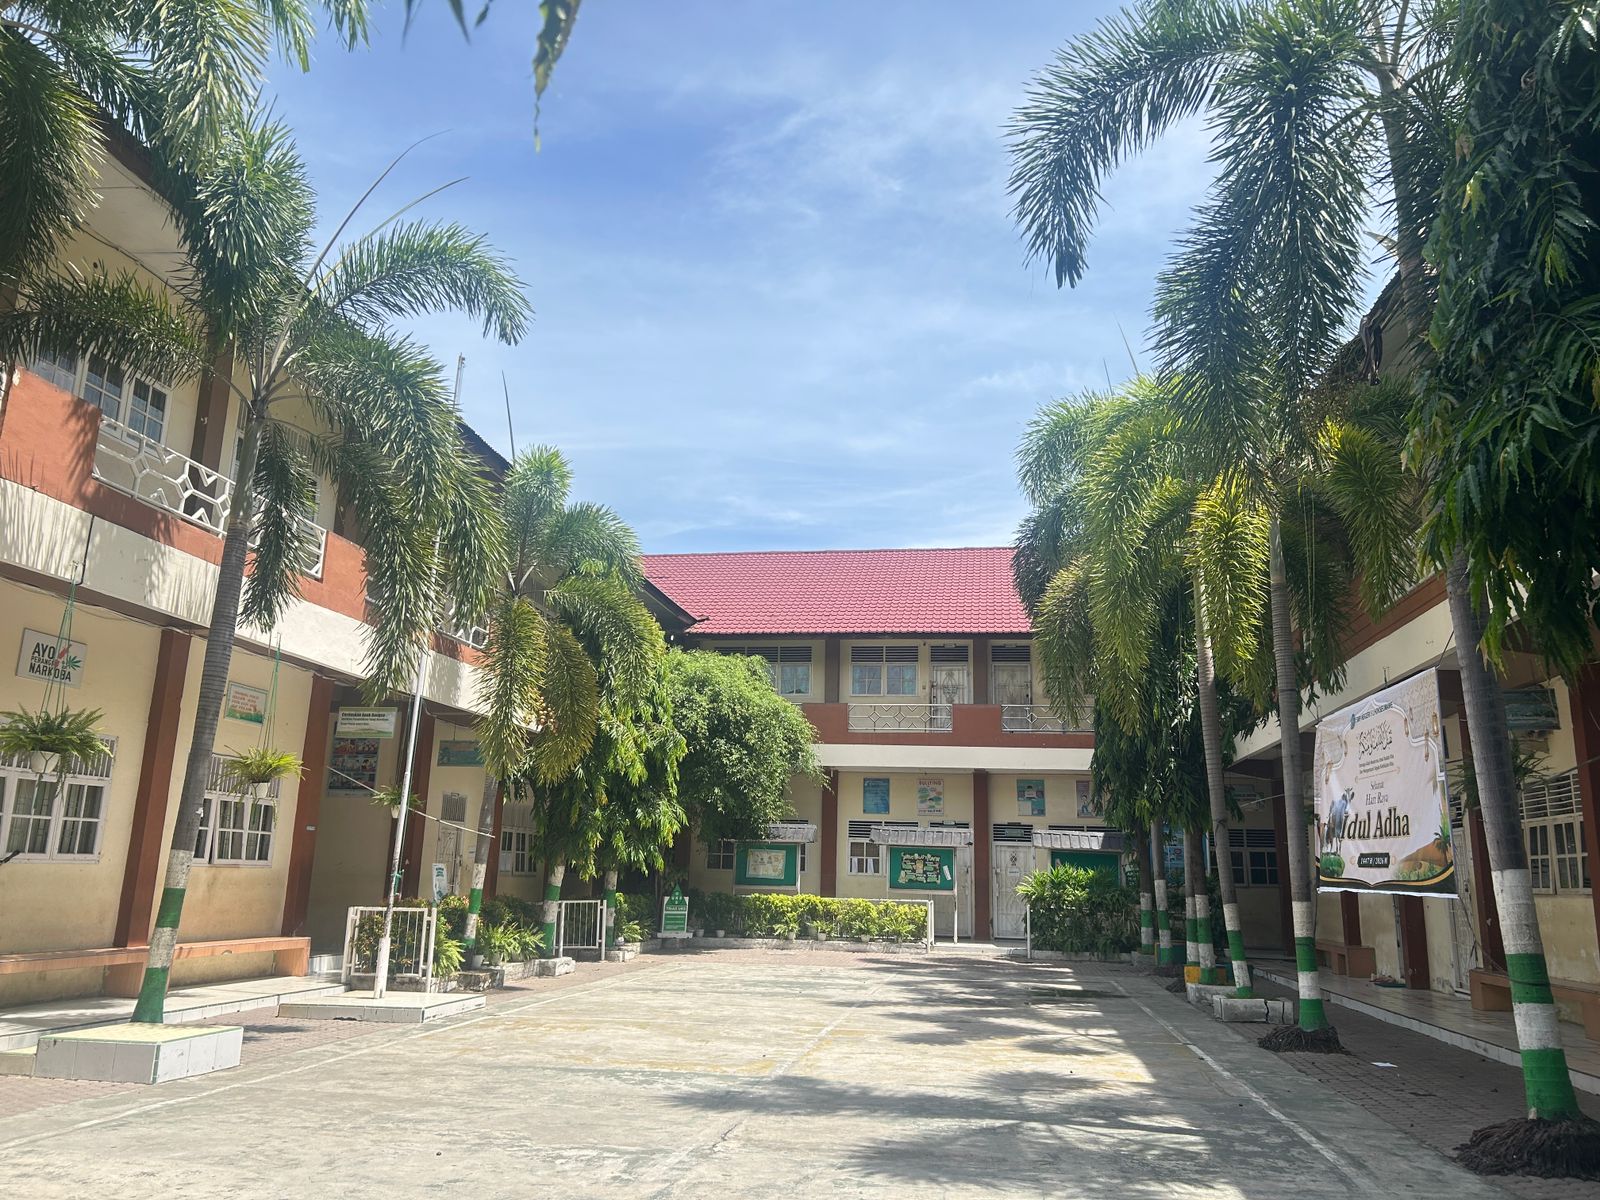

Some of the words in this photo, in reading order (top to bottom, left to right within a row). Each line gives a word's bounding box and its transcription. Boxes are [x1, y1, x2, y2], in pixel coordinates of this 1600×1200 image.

[32, 642, 56, 660] AYO
[28, 662, 72, 682] NARKOBA
[1365, 793, 1377, 806] Hari
[1377, 792, 1389, 806] Raya
[1340, 811, 1371, 840] Idul
[1373, 806, 1411, 839] Adha
